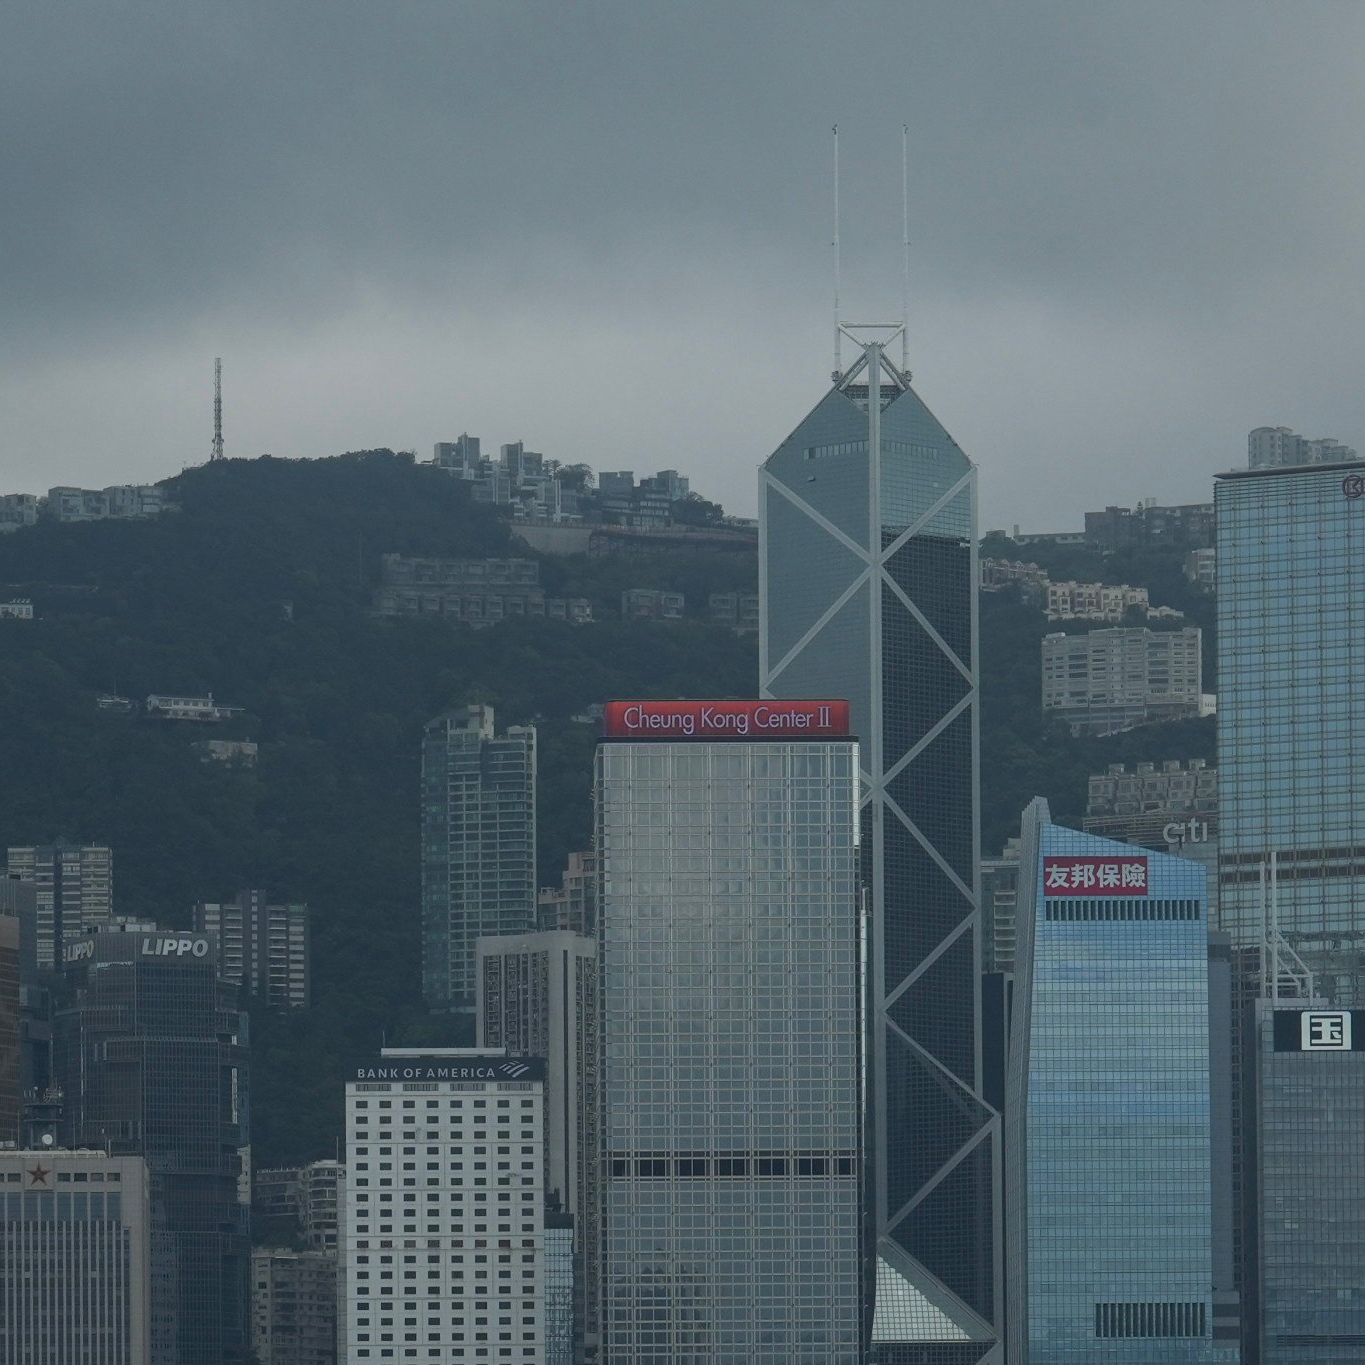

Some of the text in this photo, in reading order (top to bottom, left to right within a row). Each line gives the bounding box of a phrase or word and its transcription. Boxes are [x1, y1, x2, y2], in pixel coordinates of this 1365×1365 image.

[623, 705, 695, 735] Cheung
[701, 706, 749, 735] Kong
[754, 706, 814, 729] Center
[1162, 817, 1209, 844] citi
[1044, 863, 1147, 889] 友邦保險
[66, 939, 95, 962] LIPPO
[141, 938, 209, 958] LIPPO
[1300, 1011, 1352, 1051] 国
[357, 1067, 496, 1079] BANK OF AMERICA
